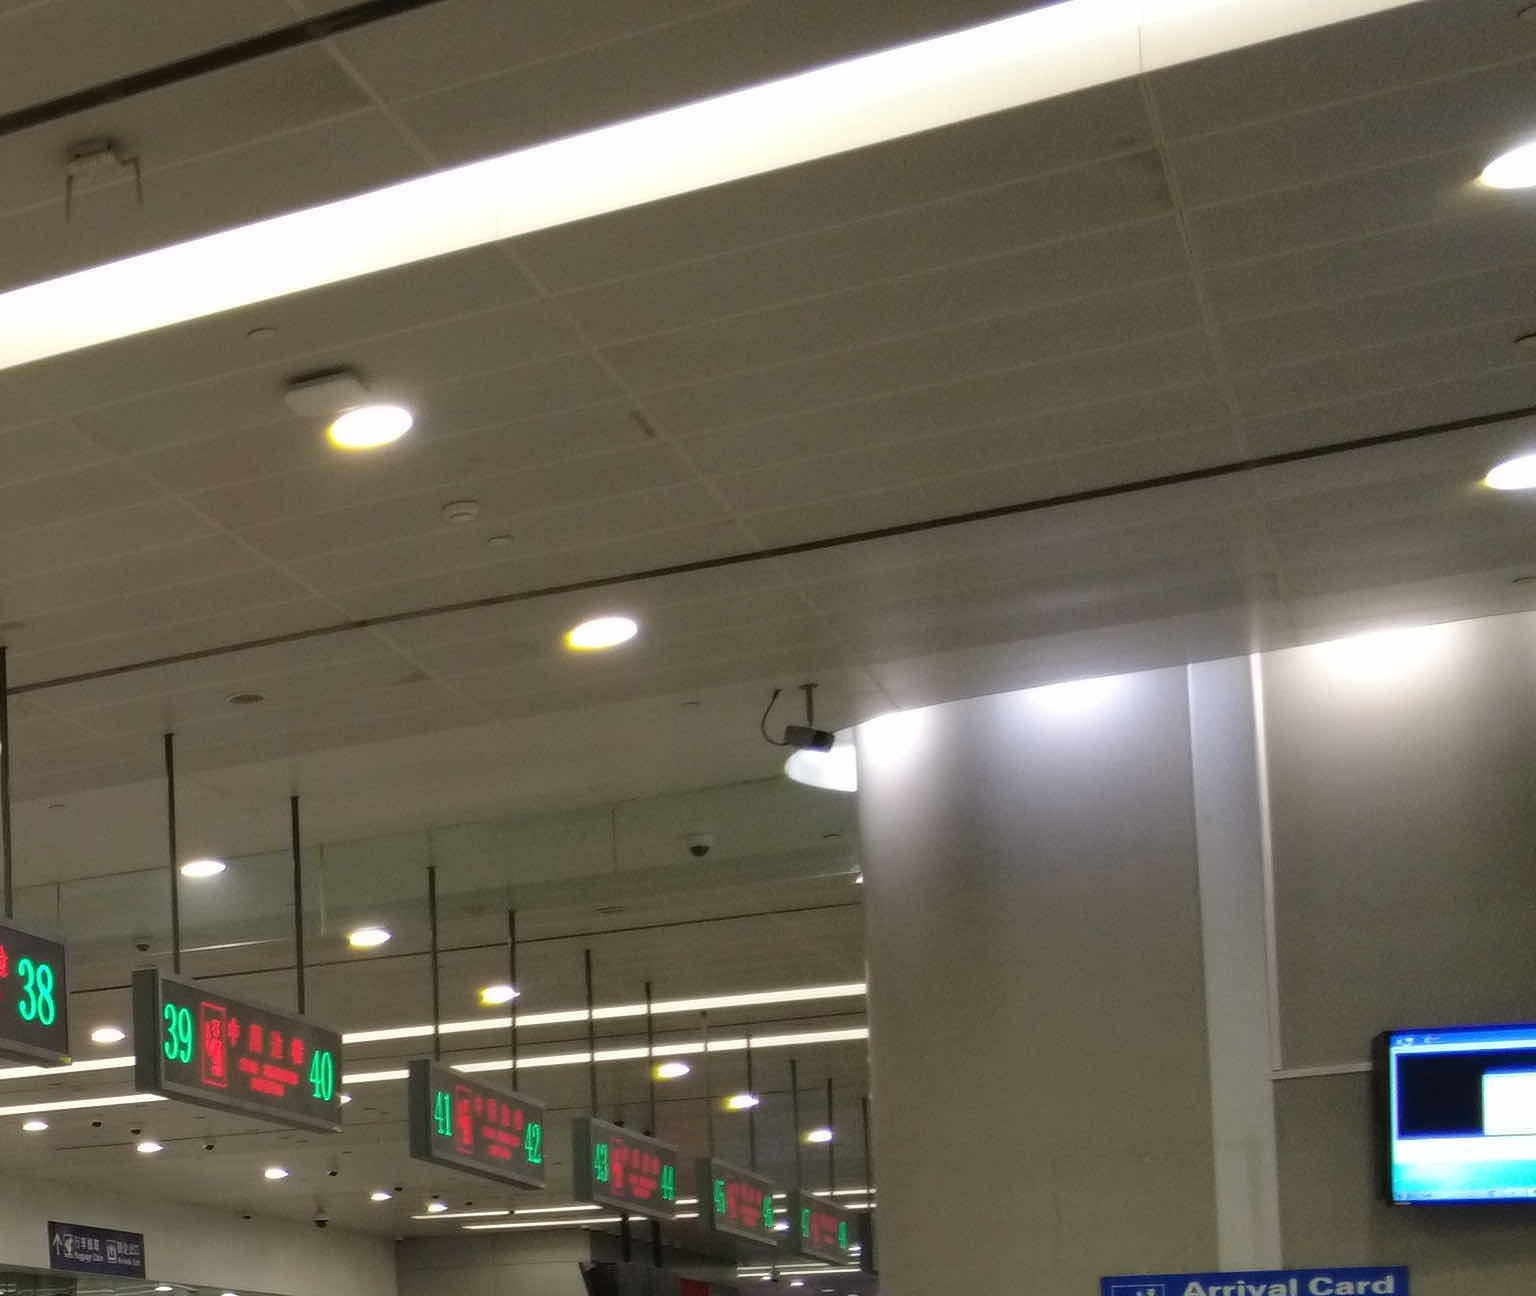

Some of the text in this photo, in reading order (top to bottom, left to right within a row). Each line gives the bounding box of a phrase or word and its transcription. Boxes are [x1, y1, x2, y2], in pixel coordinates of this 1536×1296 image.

[17, 958, 56, 1026] 38
[163, 1003, 193, 1064] 39
[309, 1050, 335, 1101] 40
[434, 1091, 453, 1137] 41
[524, 1122, 542, 1164] 42
[1308, 1275, 1395, 1296] Card
